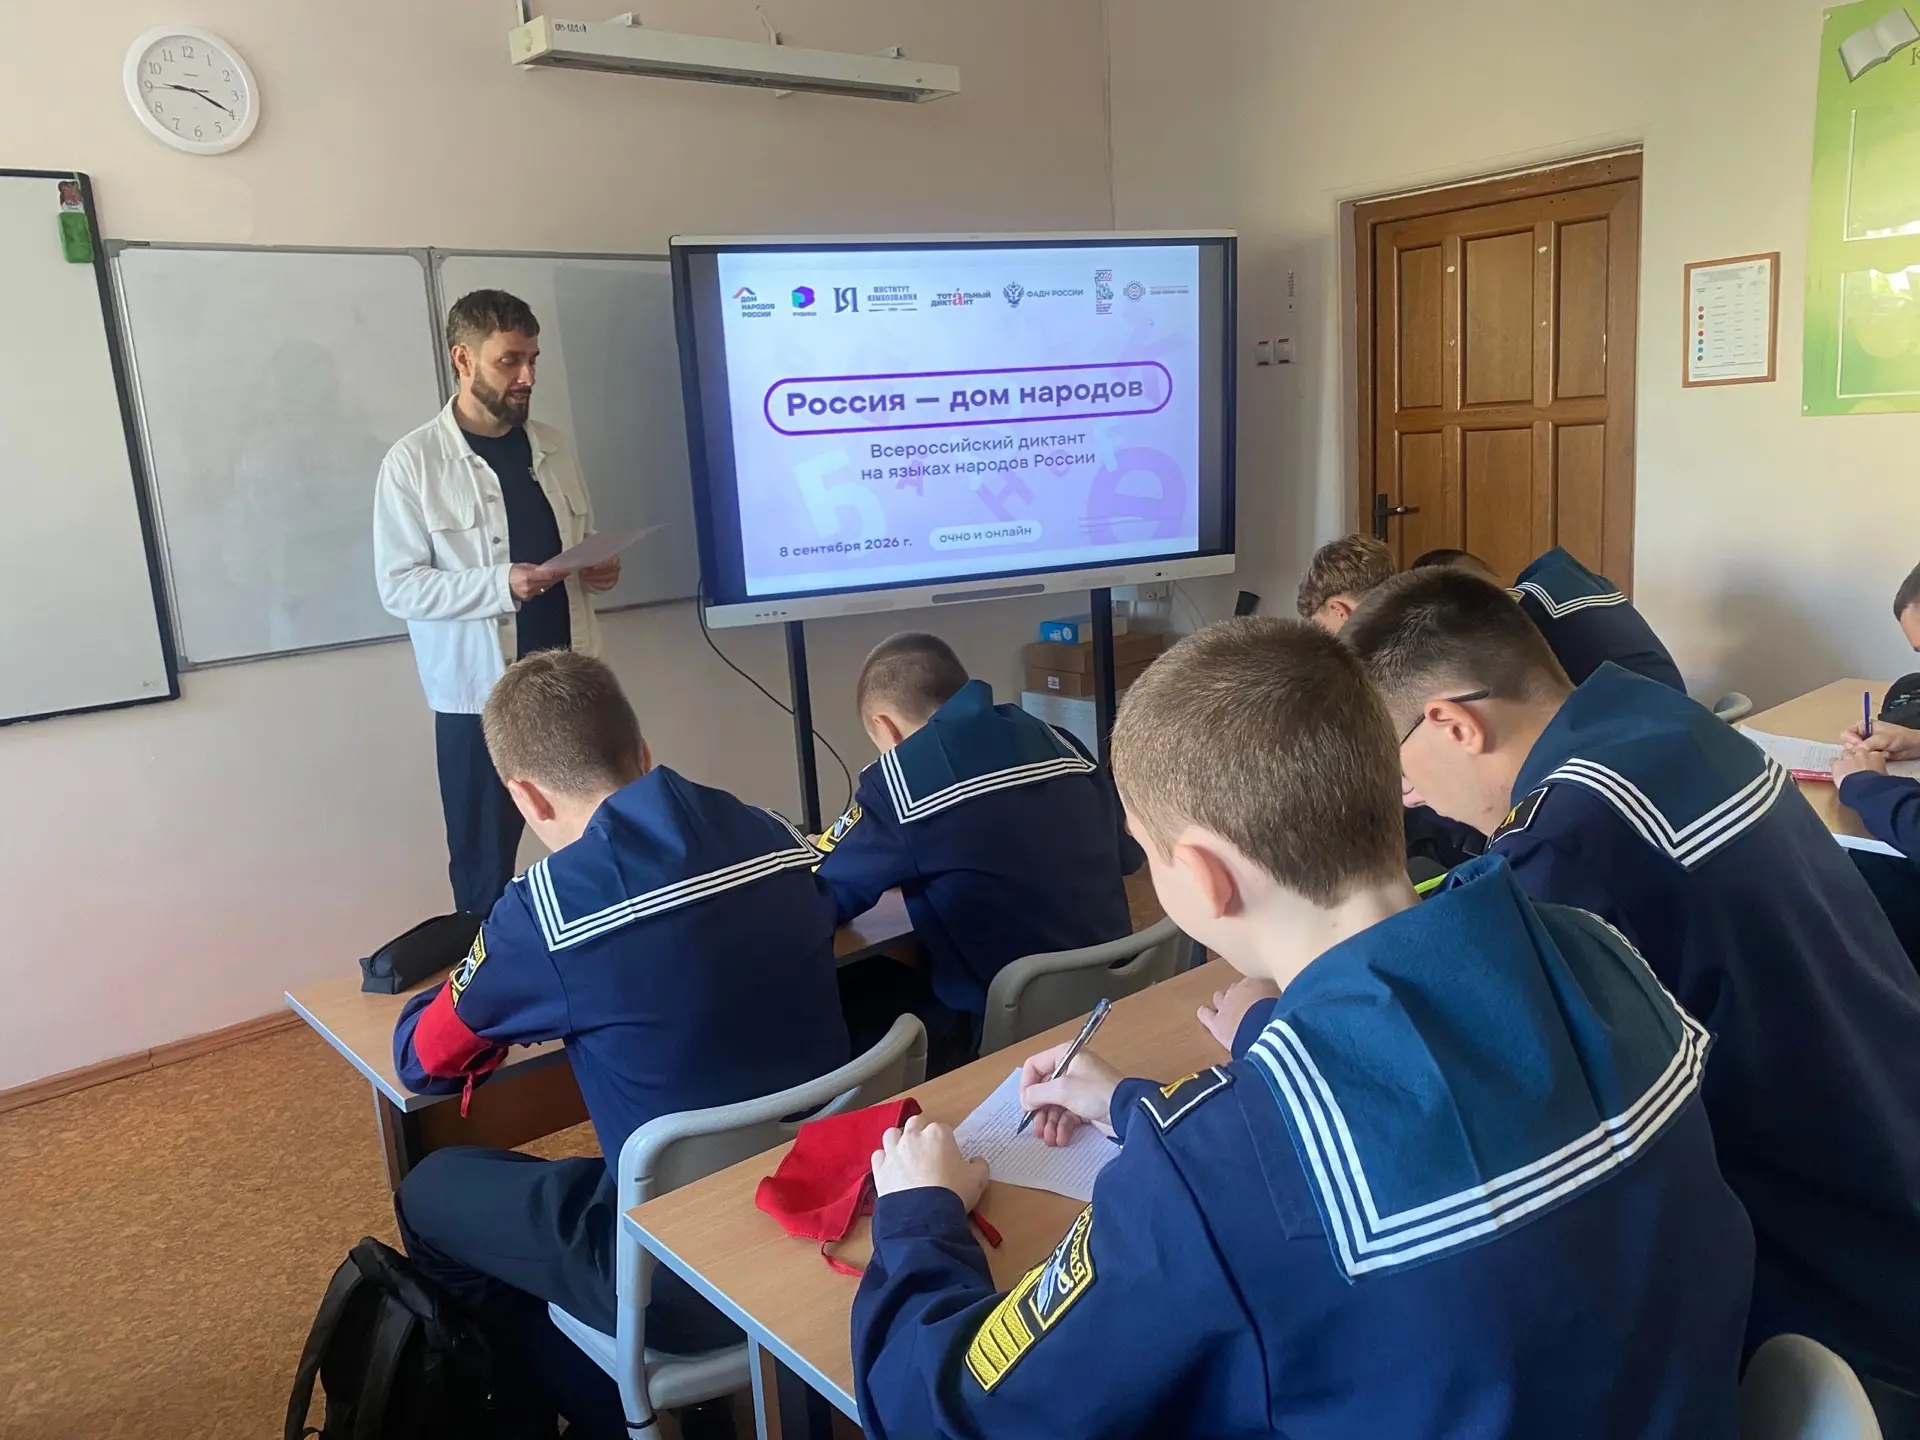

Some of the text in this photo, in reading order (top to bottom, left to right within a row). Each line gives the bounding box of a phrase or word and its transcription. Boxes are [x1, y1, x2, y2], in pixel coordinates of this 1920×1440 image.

[163, 49, 175, 62] 11
[182, 45, 195, 58] 12
[206, 54, 212, 66] 1
[149, 62, 162, 75] 10
[222, 69, 231, 82] 2
[144, 80, 153, 92] 9
[231, 90, 239, 102] 3
[155, 101, 163, 113] 8
[228, 109, 236, 120] 4
[172, 117, 180, 130] 7
[214, 121, 222, 133] 5
[194, 125, 203, 137] 6
[873, 286, 910, 294] ИНСТИТУТ
[1027, 289, 1084, 298] ФАДН РОССИИ
[867, 294, 918, 302] ЯЗЫКОЗНАНИЯ
[787, 392, 906, 417] Россия
[949, 387, 1010, 413] дом
[1019, 378, 1143, 405] народов
[870, 433, 1086, 459] Всероссийский диктант
[861, 451, 1096, 481] на языках народов России
[939, 525, 1032, 543] очно и онлайн
[779, 536, 913, 558] 8 сентября 2026 г.
